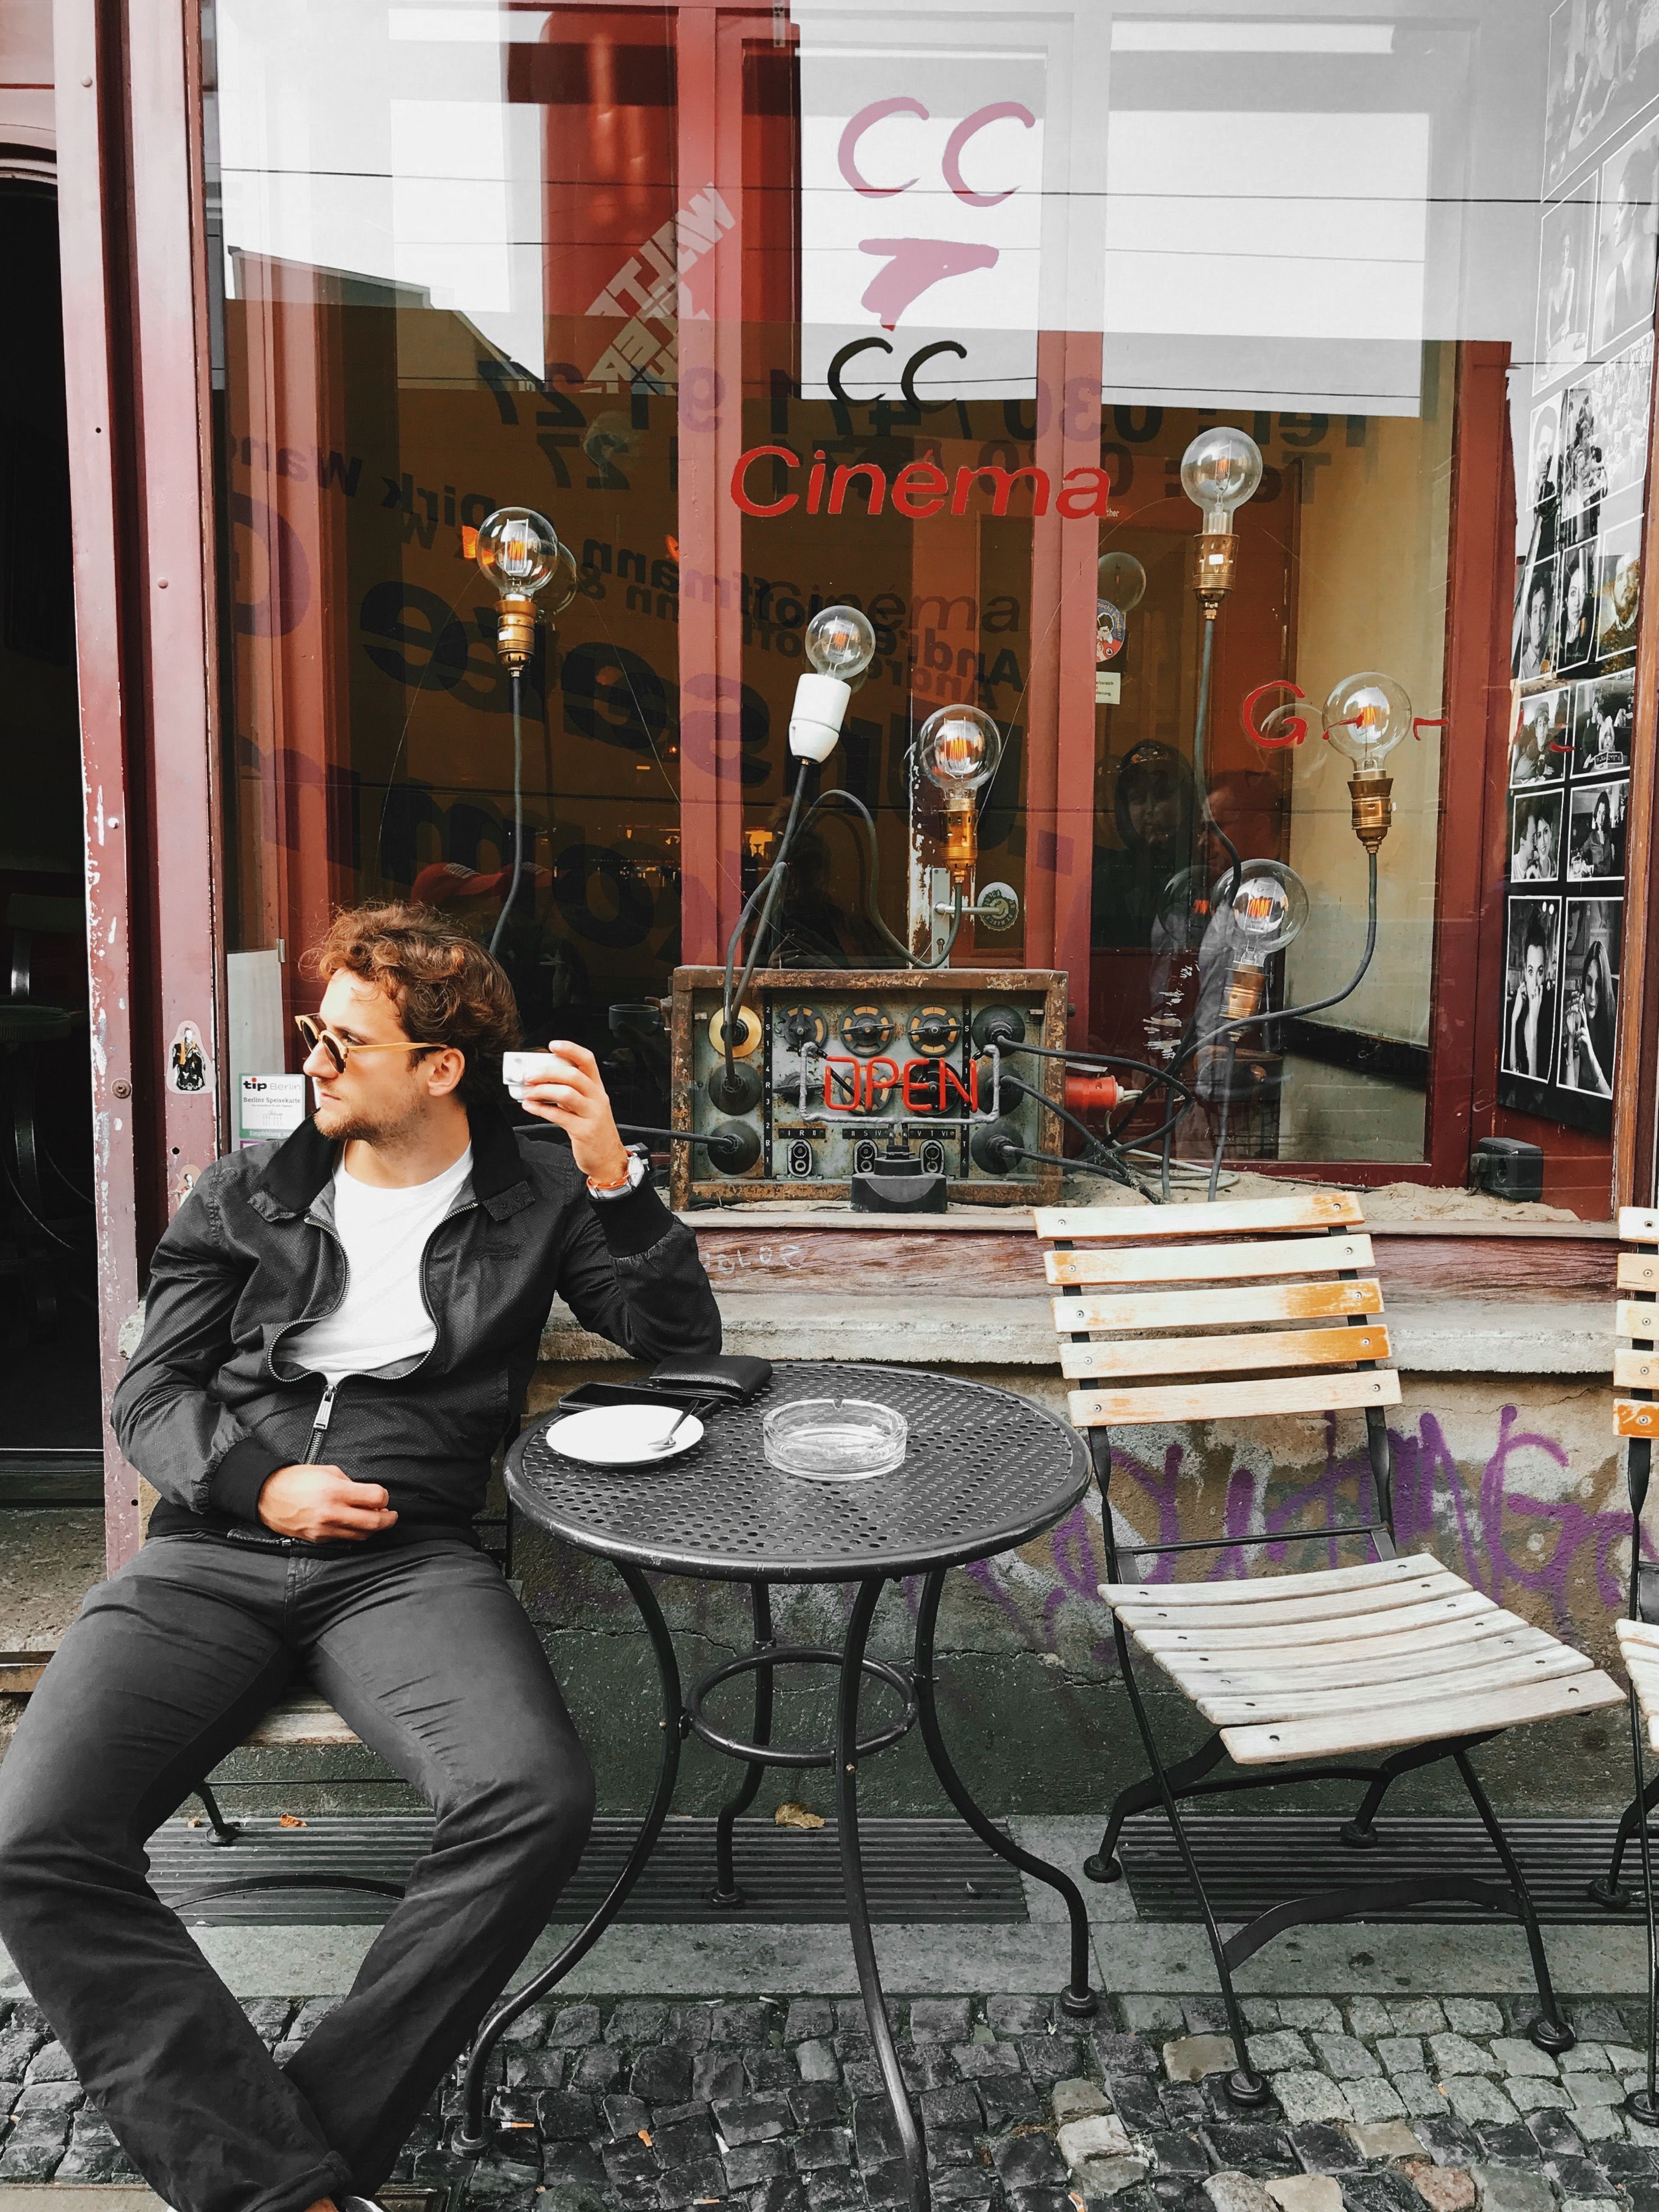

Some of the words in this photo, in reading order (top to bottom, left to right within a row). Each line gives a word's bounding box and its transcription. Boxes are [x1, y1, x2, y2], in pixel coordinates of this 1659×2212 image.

[731, 446, 1110, 519] Cinéma
[243, 1077, 268, 1091] tip
[824, 1055, 978, 1113] OPEN
